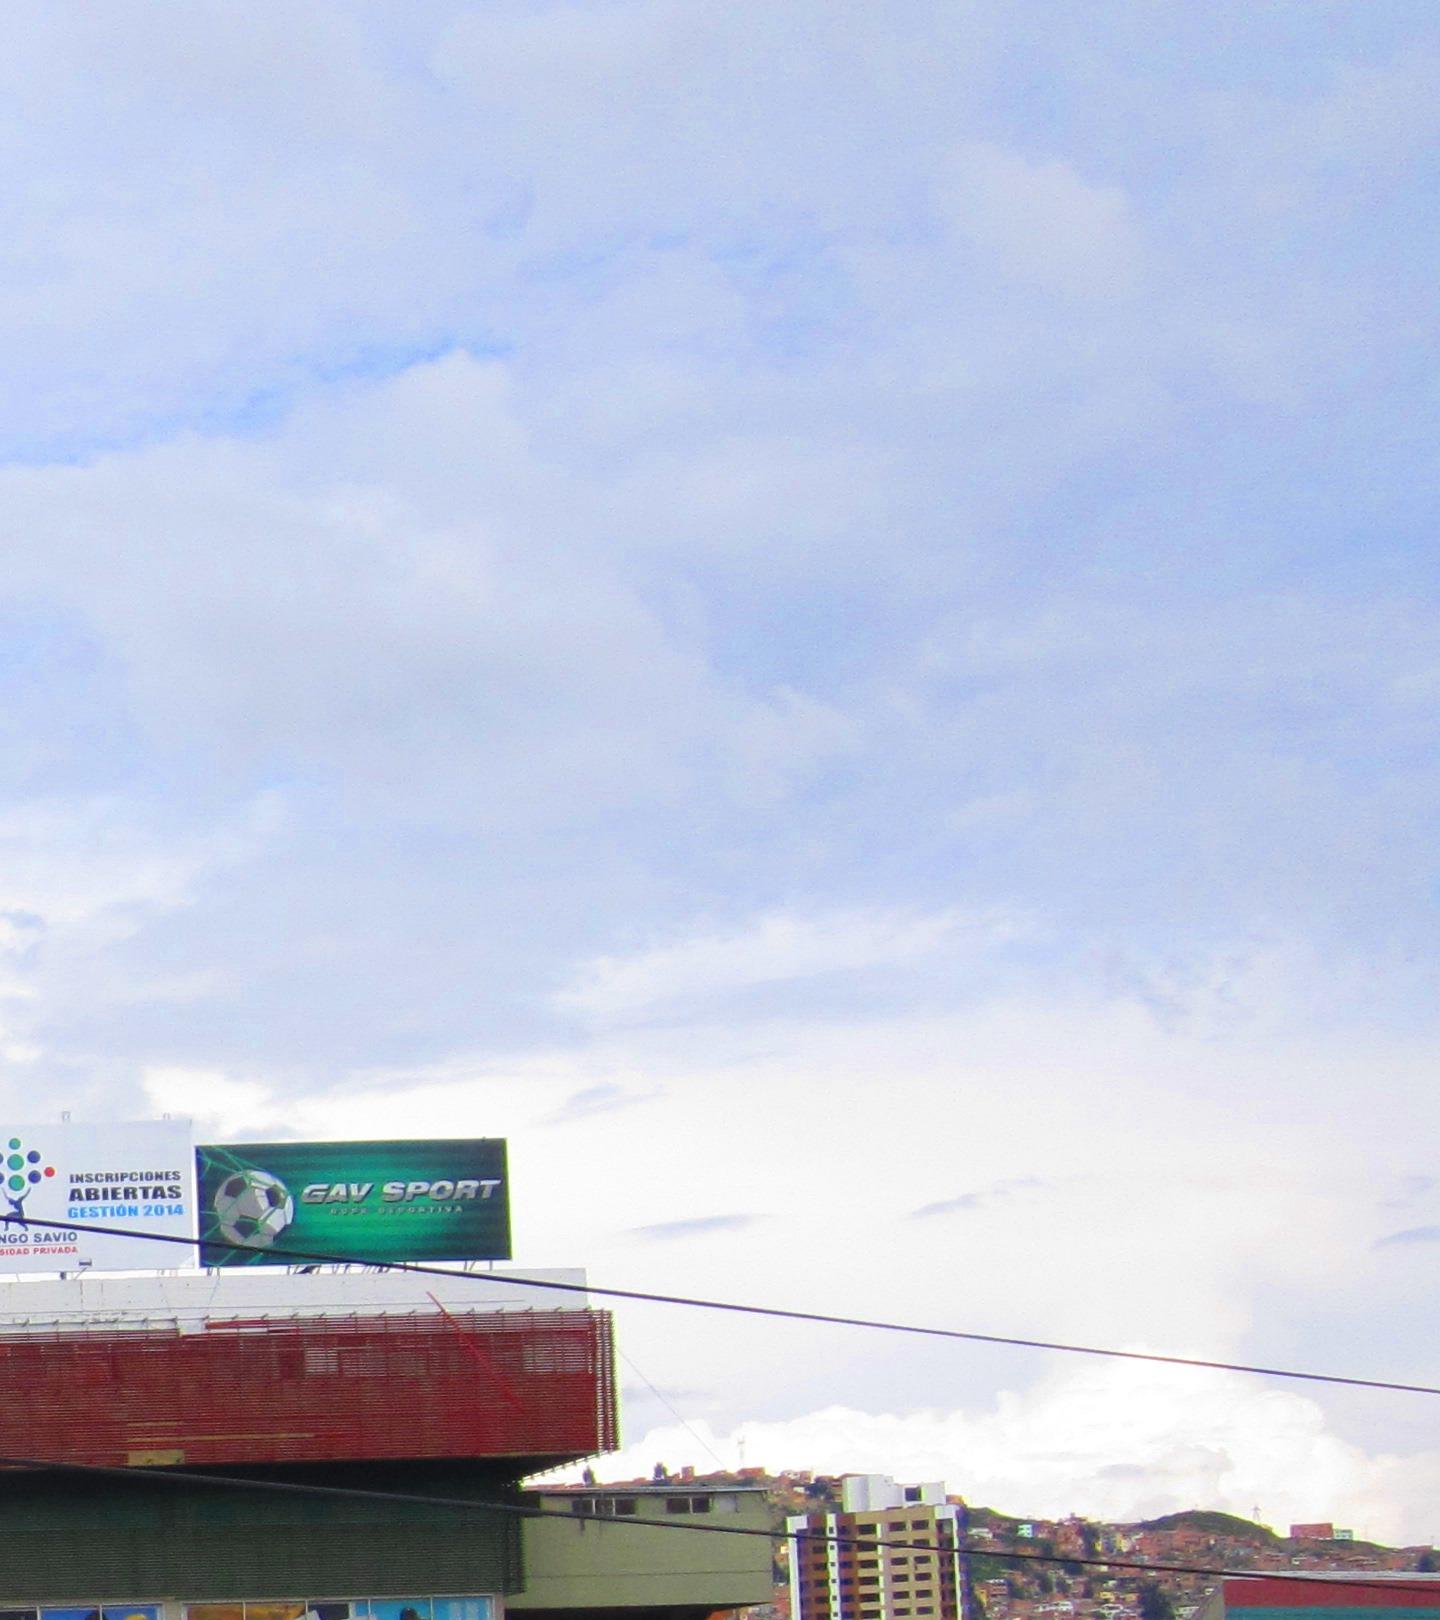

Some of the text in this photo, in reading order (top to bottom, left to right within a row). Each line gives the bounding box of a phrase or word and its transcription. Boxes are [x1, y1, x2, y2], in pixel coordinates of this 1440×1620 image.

[69, 1171, 181, 1184] INSCRIPCIONES
[69, 1185, 183, 1201] ABIERTAS
[301, 1179, 502, 1205] GAV SPORT
[67, 1203, 184, 1218] GESTIÓN 2014
[33, 1231, 78, 1244] SAVIO
[33, 1246, 78, 1255] PRIVADA
